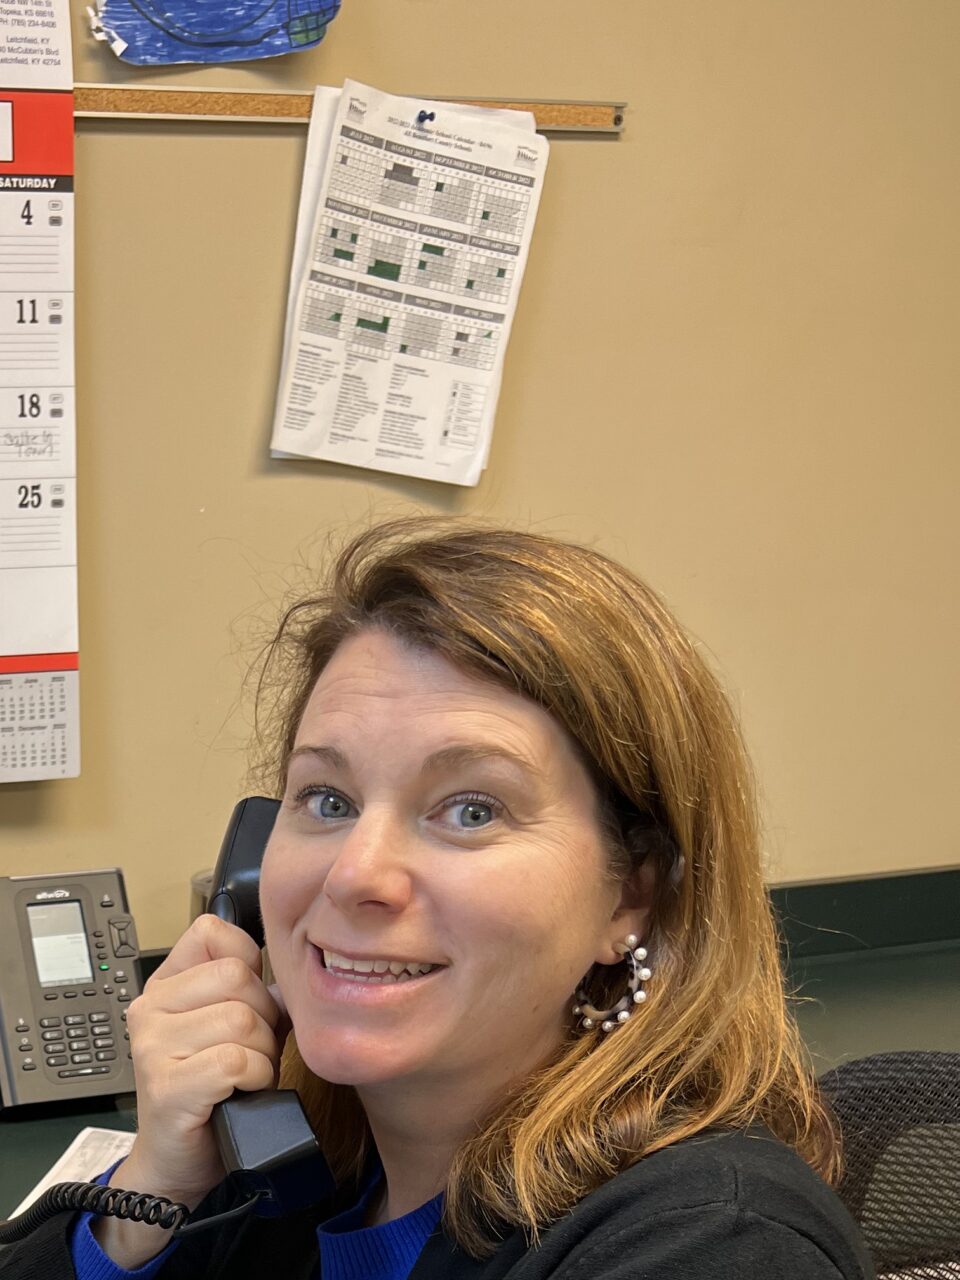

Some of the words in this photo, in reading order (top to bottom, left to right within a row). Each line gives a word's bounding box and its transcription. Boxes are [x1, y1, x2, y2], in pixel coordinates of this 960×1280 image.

[20, 199, 33, 225] 4
[16, 299, 39, 324] 11
[17, 393, 41, 418] 18
[17, 484, 42, 509] 25
